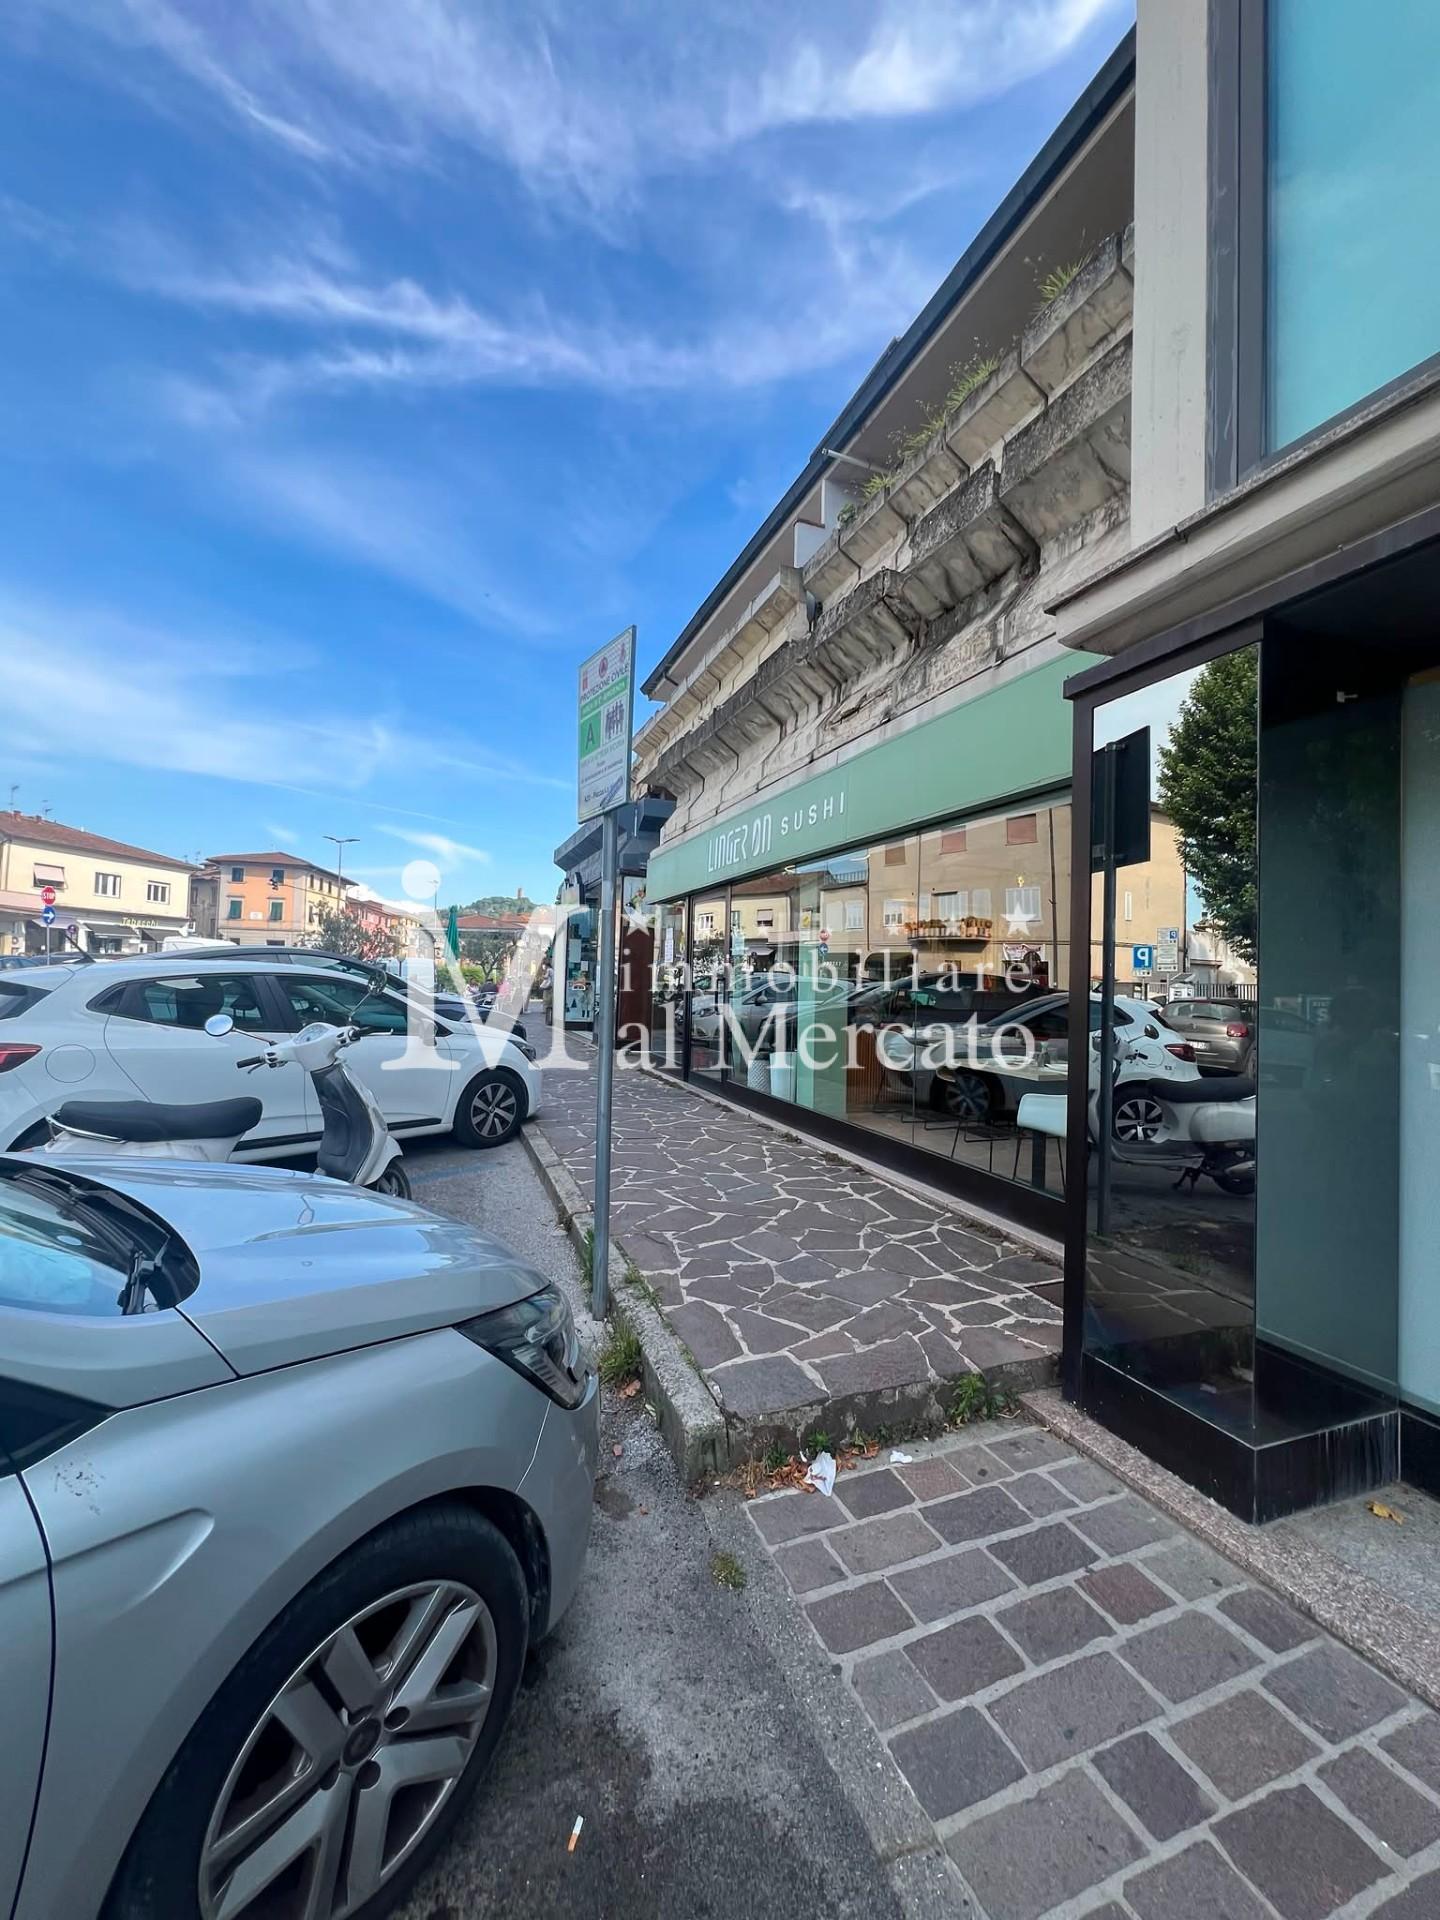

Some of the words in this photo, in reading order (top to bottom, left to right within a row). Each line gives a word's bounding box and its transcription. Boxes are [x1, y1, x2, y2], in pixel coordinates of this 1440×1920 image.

[580, 677, 610, 703] PROTEZIONE
[585, 722, 595, 751] A
[780, 791, 846, 836] SUSHI
[42, 891, 56, 900] STOP
[121, 917, 160, 928] Tabacchi
